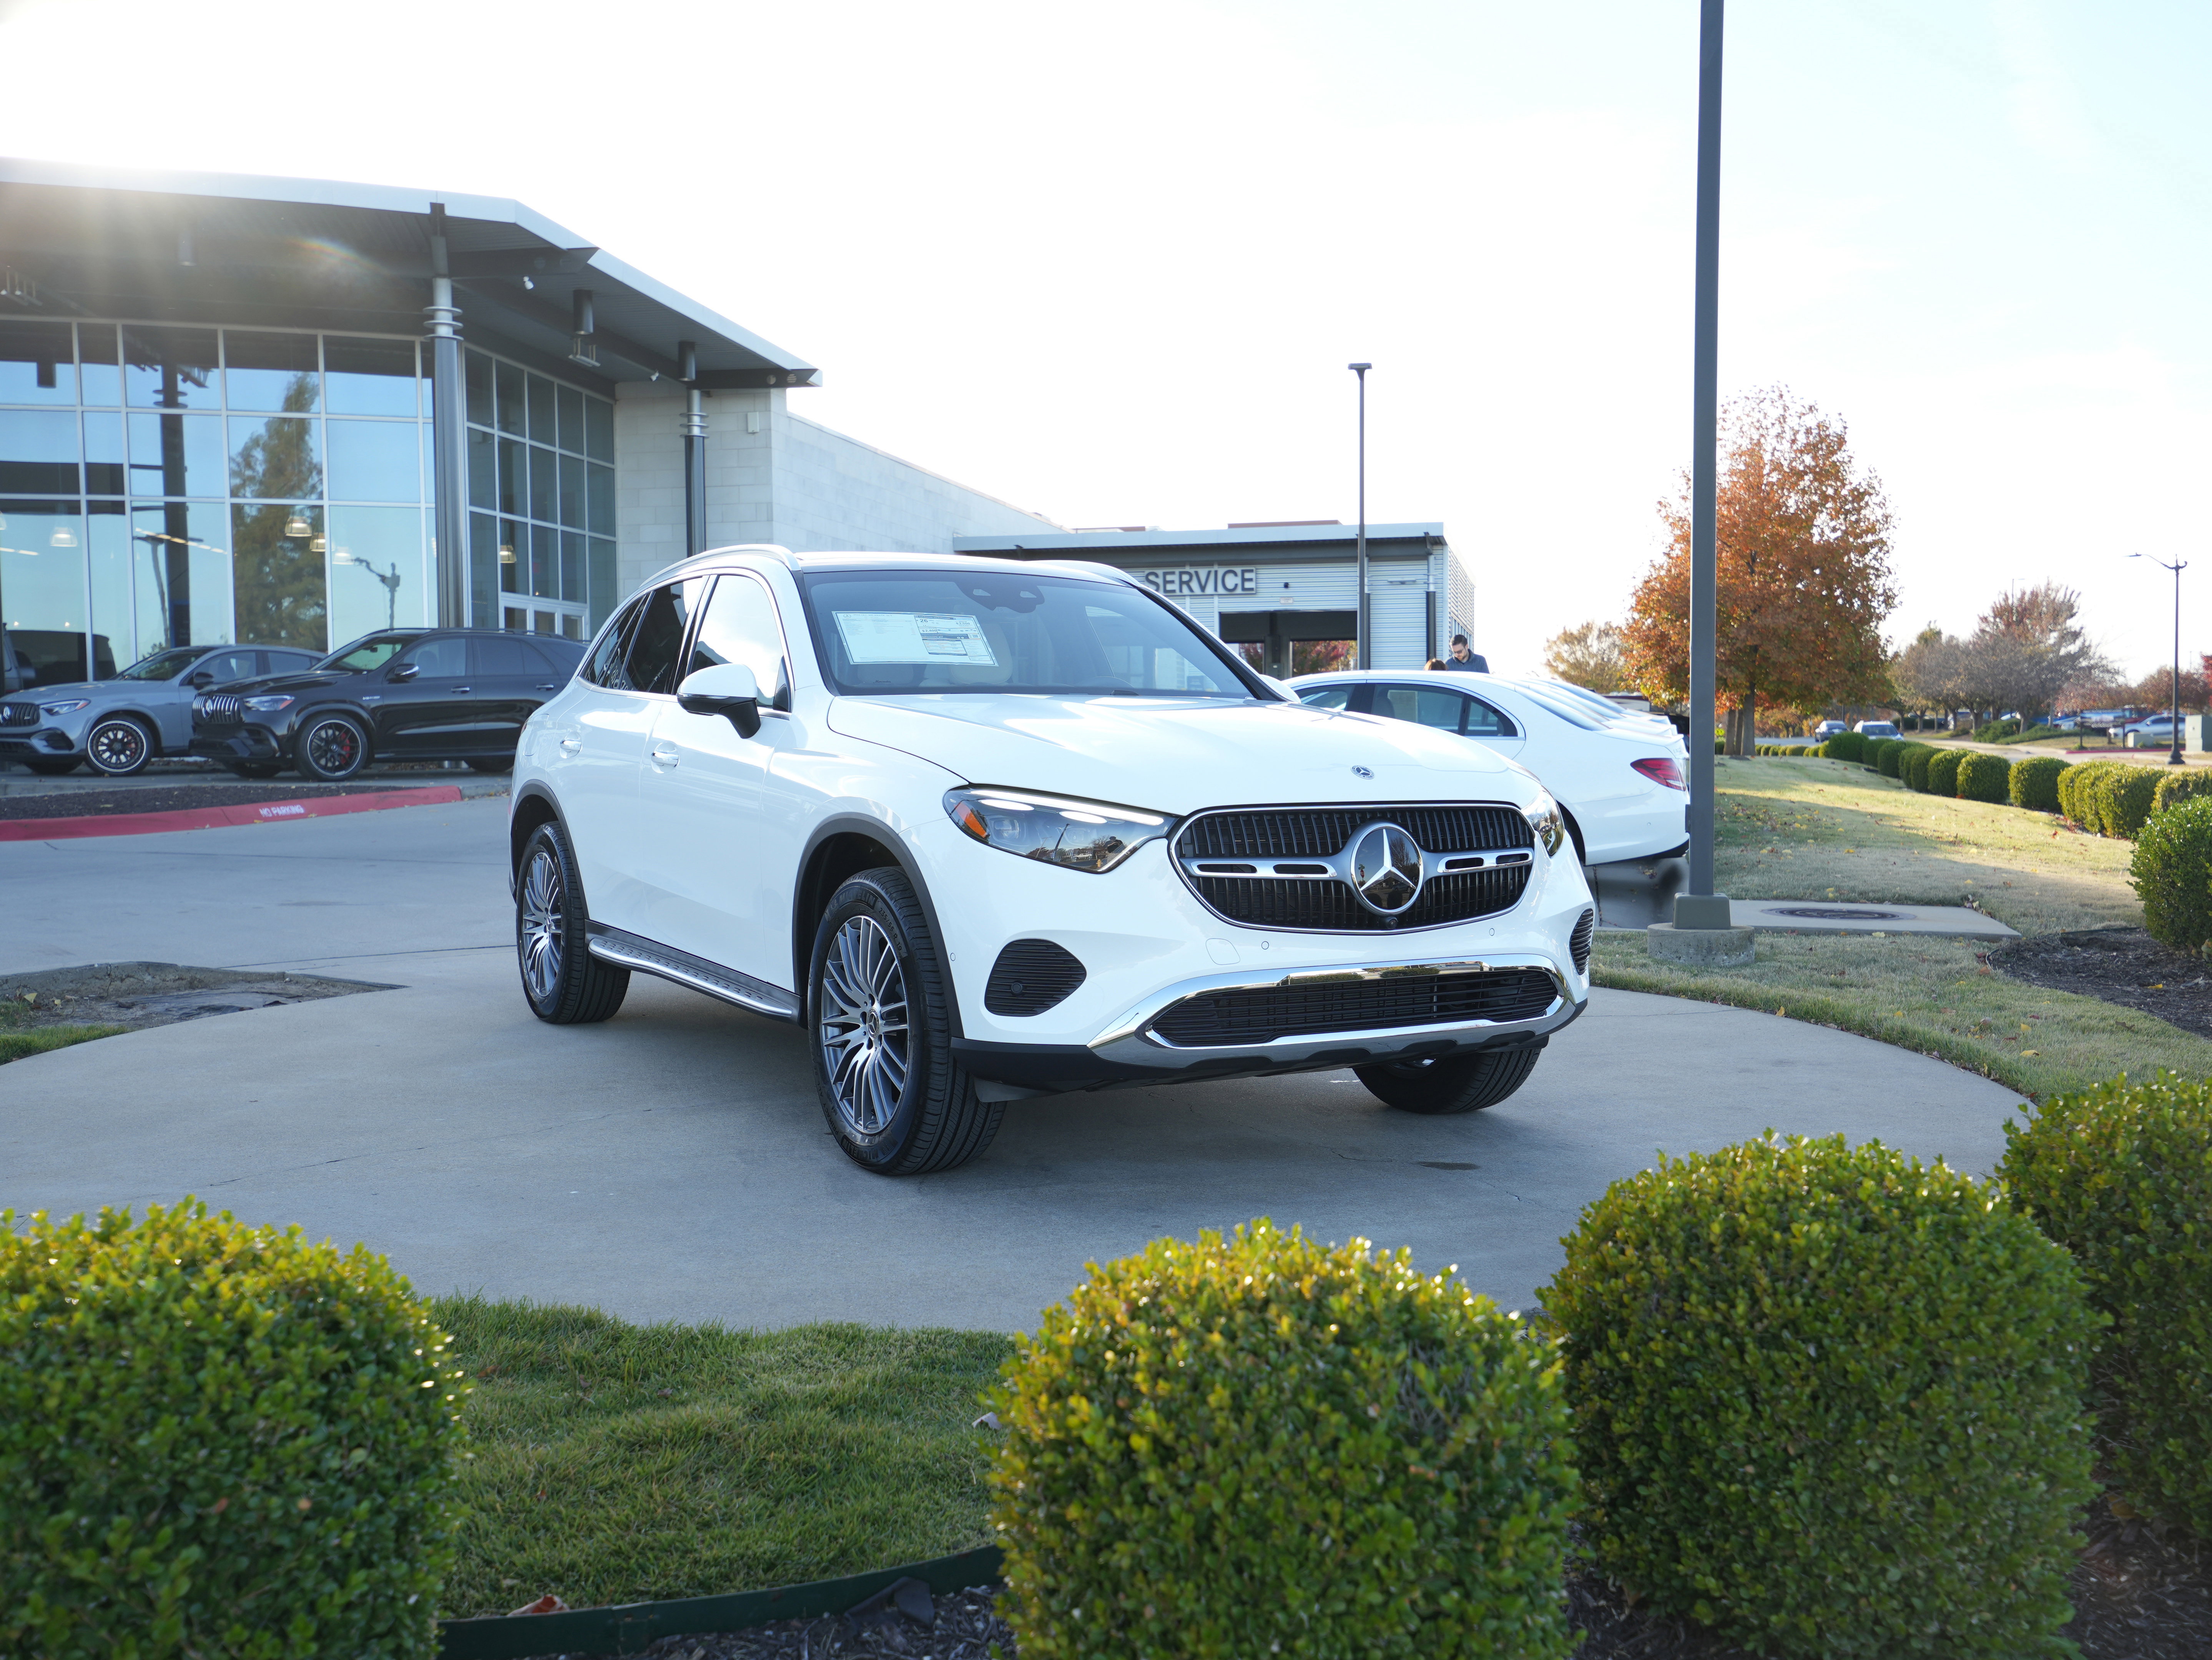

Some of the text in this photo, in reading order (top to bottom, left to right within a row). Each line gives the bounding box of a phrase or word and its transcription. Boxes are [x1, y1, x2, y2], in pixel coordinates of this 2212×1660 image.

[1145, 569, 1255, 594] SERVICE
[259, 804, 305, 818] NO PARKING
[878, 908, 894, 932] 235/55
[896, 942, 902, 951] 19
[823, 1103, 839, 1135] PRIMACY
